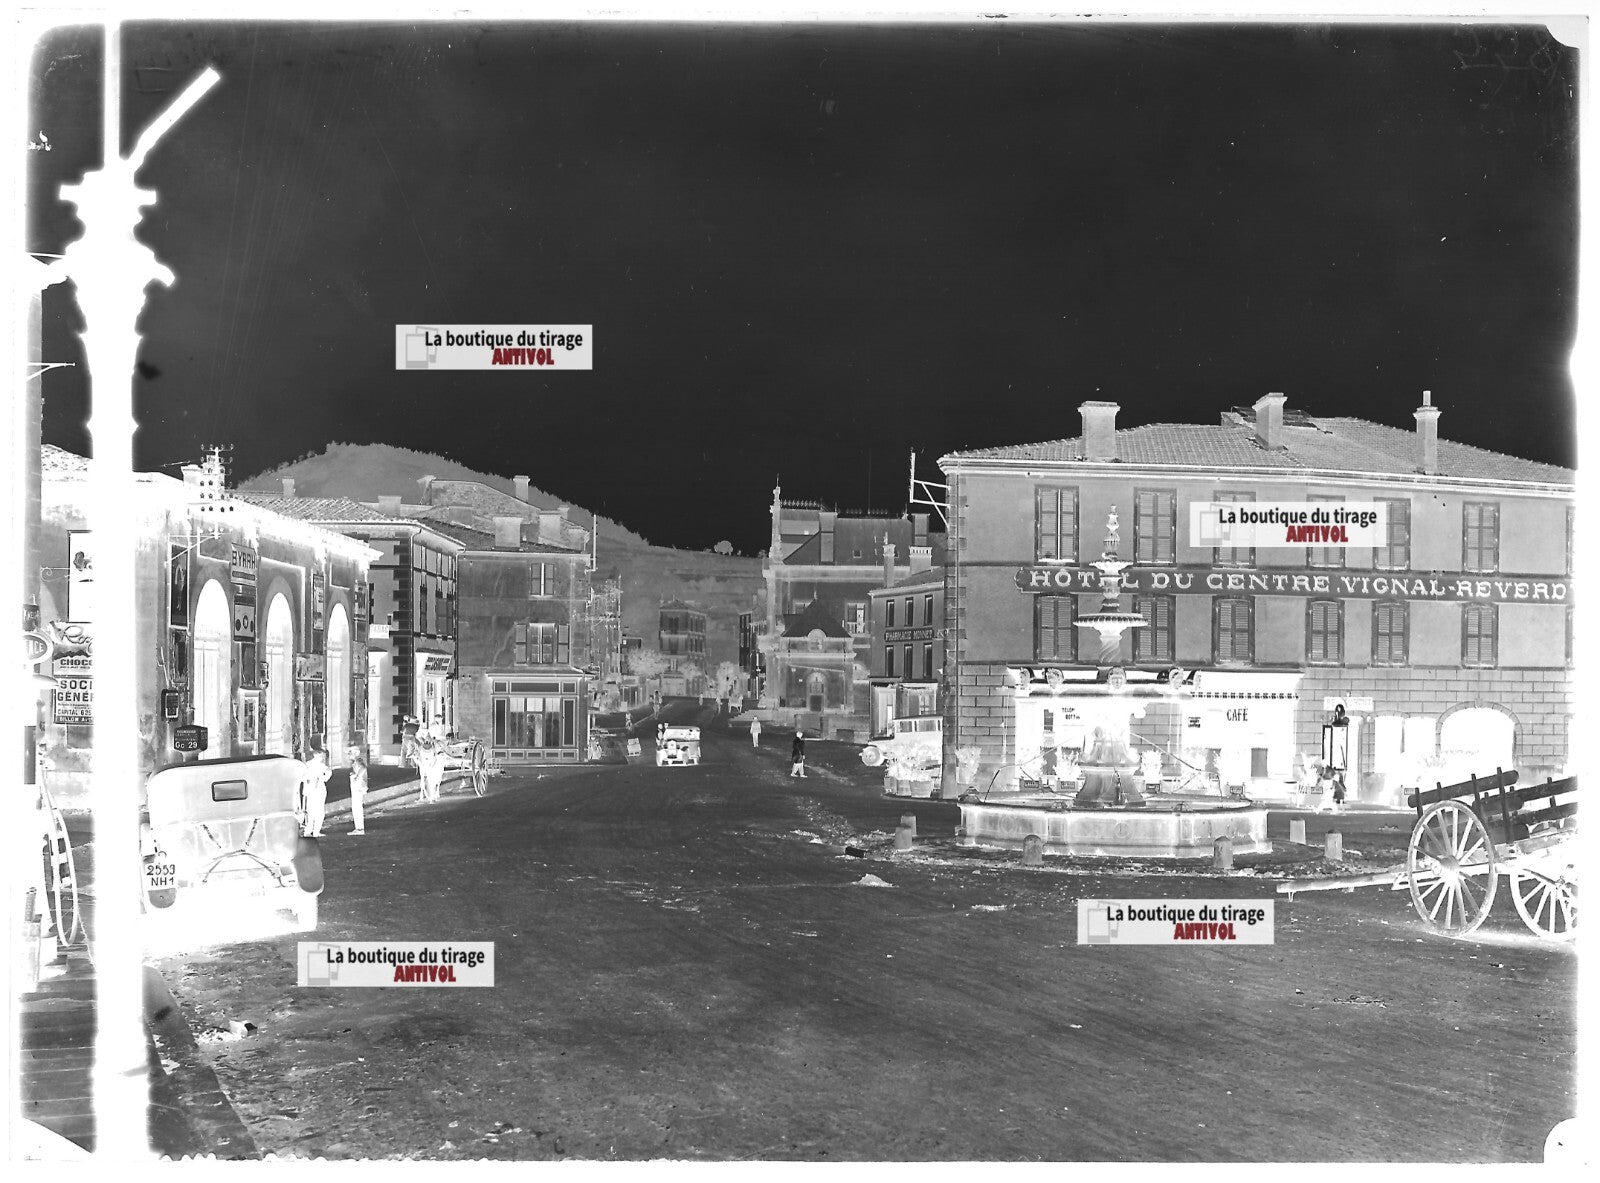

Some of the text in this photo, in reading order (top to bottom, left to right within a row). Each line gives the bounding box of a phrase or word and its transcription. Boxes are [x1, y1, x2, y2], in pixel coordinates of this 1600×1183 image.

[232, 551, 256, 569] BYRRH
[1029, 568, 1139, 588] HÔTL
[1151, 572, 1194, 589] DU
[1226, 706, 1249, 721] CAFÉ
[188, 741, 198, 749] 29
